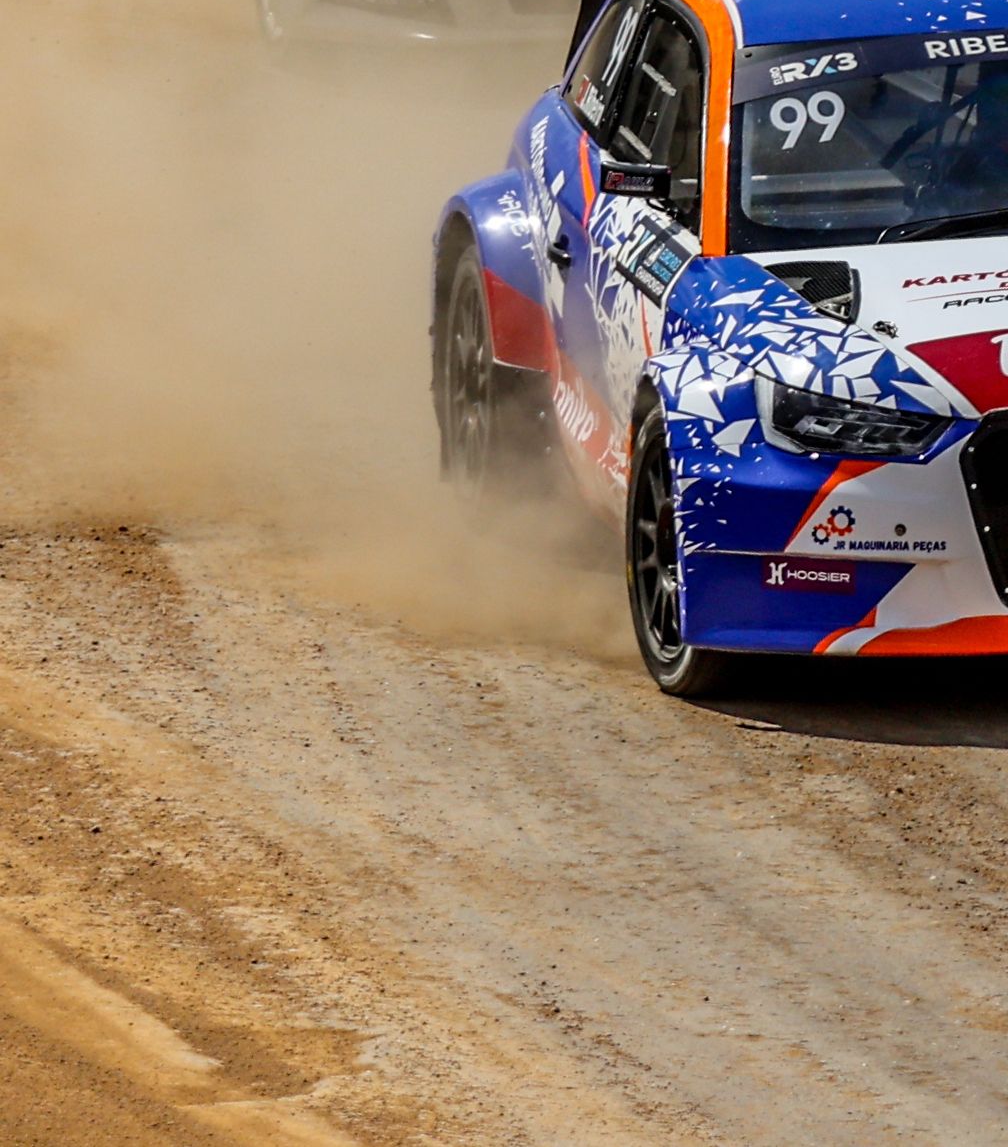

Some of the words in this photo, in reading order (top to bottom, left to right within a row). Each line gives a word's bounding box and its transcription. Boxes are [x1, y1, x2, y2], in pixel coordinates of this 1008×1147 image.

[780, 52, 859, 84] RX3
[769, 90, 846, 151] 99
[834, 540, 846, 551] JR
[849, 541, 910, 552] MAQUINARIA
[912, 542, 947, 553] PEÇAS
[787, 569, 851, 583] HOOSIER
